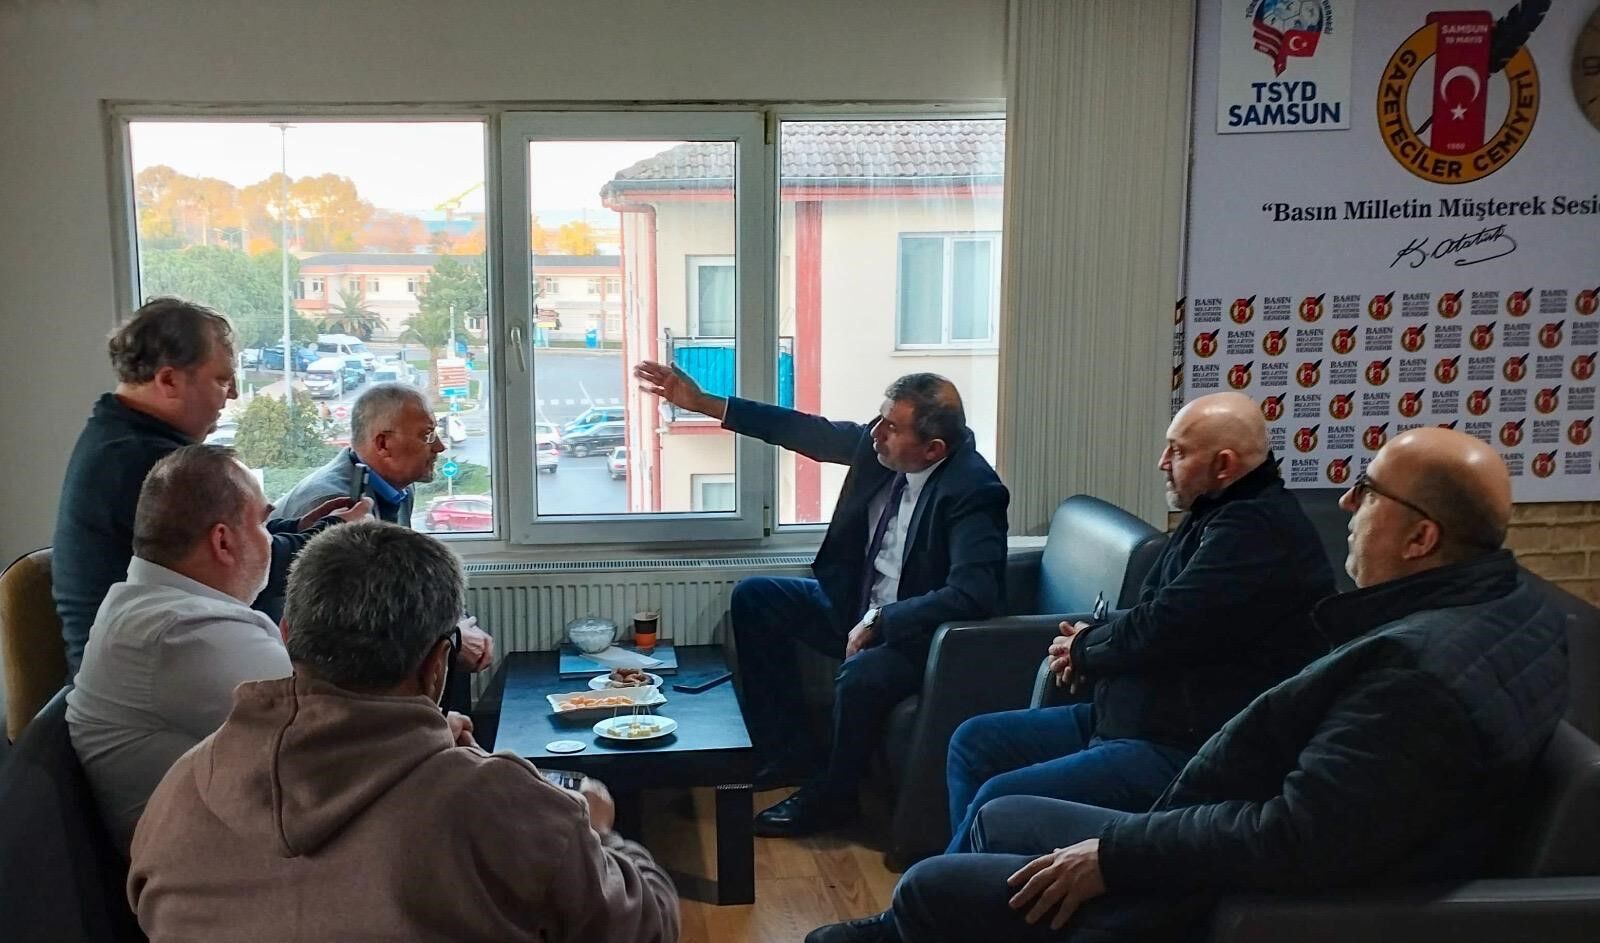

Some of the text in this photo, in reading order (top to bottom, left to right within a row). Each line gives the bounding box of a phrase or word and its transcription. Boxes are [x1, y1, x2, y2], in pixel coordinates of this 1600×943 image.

[1441, 24, 1489, 34] SAMSUN
[1252, 81, 1317, 103] TSYD
[1229, 102, 1340, 126] SAMSUN
[1383, 49, 1463, 178] GAZETECİLER
[1344, 200, 1431, 220] Milletin
[1438, 196, 1546, 222] Müşterek
[1333, 294, 1361, 303] BASIN
[1402, 292, 1431, 301] BASIN
[1471, 291, 1500, 299] BASIN
[1194, 298, 1223, 306] BASIN
[1264, 296, 1292, 305] BASIN
[1296, 328, 1325, 337] BASIN
[1365, 326, 1394, 335] BASIN
[1435, 324, 1463, 333] BASIN
[1227, 330, 1255, 338] BASIN
[1330, 360, 1358, 368] BASIN
[1399, 358, 1427, 367] BASIN
[1468, 356, 1496, 365] BASIN
[1192, 364, 1220, 372] BASIN
[1261, 362, 1289, 370] BASIN
[1294, 394, 1322, 402] BASIN
[1363, 392, 1391, 400] BASIN
[1432, 390, 1460, 399] BASIN
[1328, 425, 1356, 434] BASIN
[1465, 421, 1494, 430] BASIN
[1292, 458, 1320, 467] BASIN
